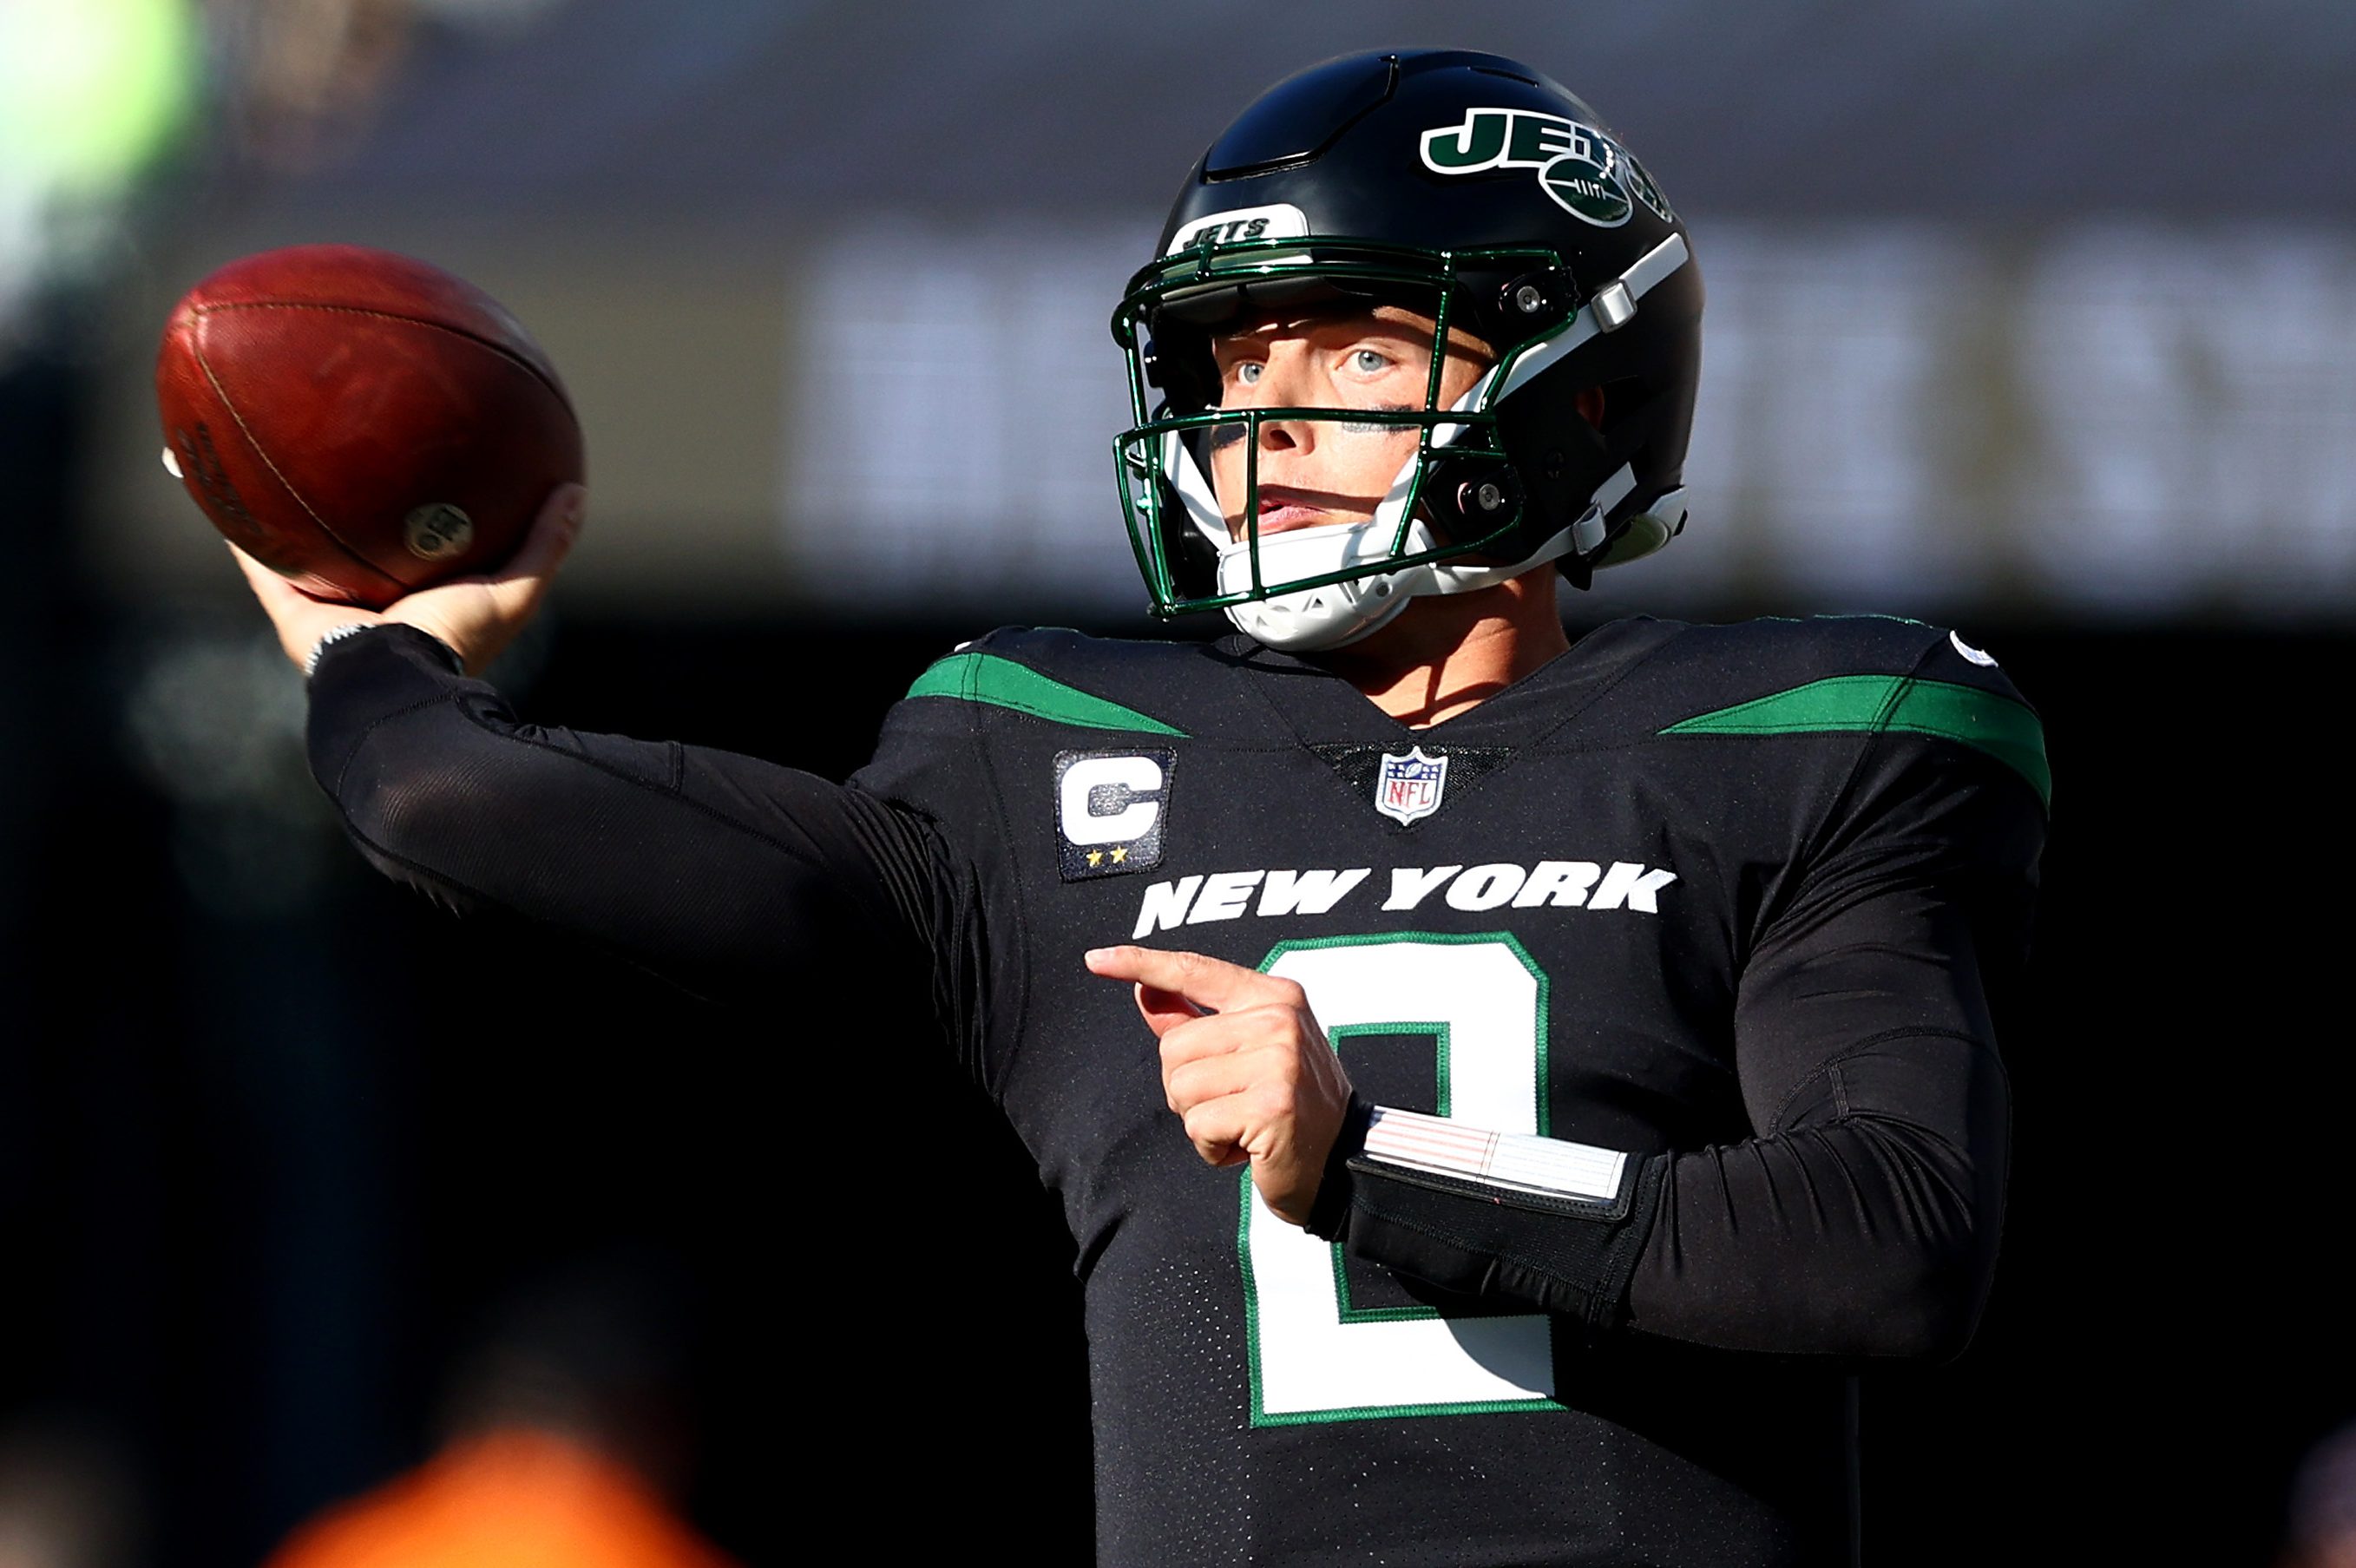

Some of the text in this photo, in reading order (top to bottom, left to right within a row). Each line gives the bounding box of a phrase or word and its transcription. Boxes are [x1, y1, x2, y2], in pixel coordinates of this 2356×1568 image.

[1183, 218, 1270, 250] JETS
[1057, 755, 1164, 846] C
[1388, 780, 1431, 807] NFL
[1132, 860, 1677, 939] NEW YORK
[1239, 930, 1569, 1427] 2
